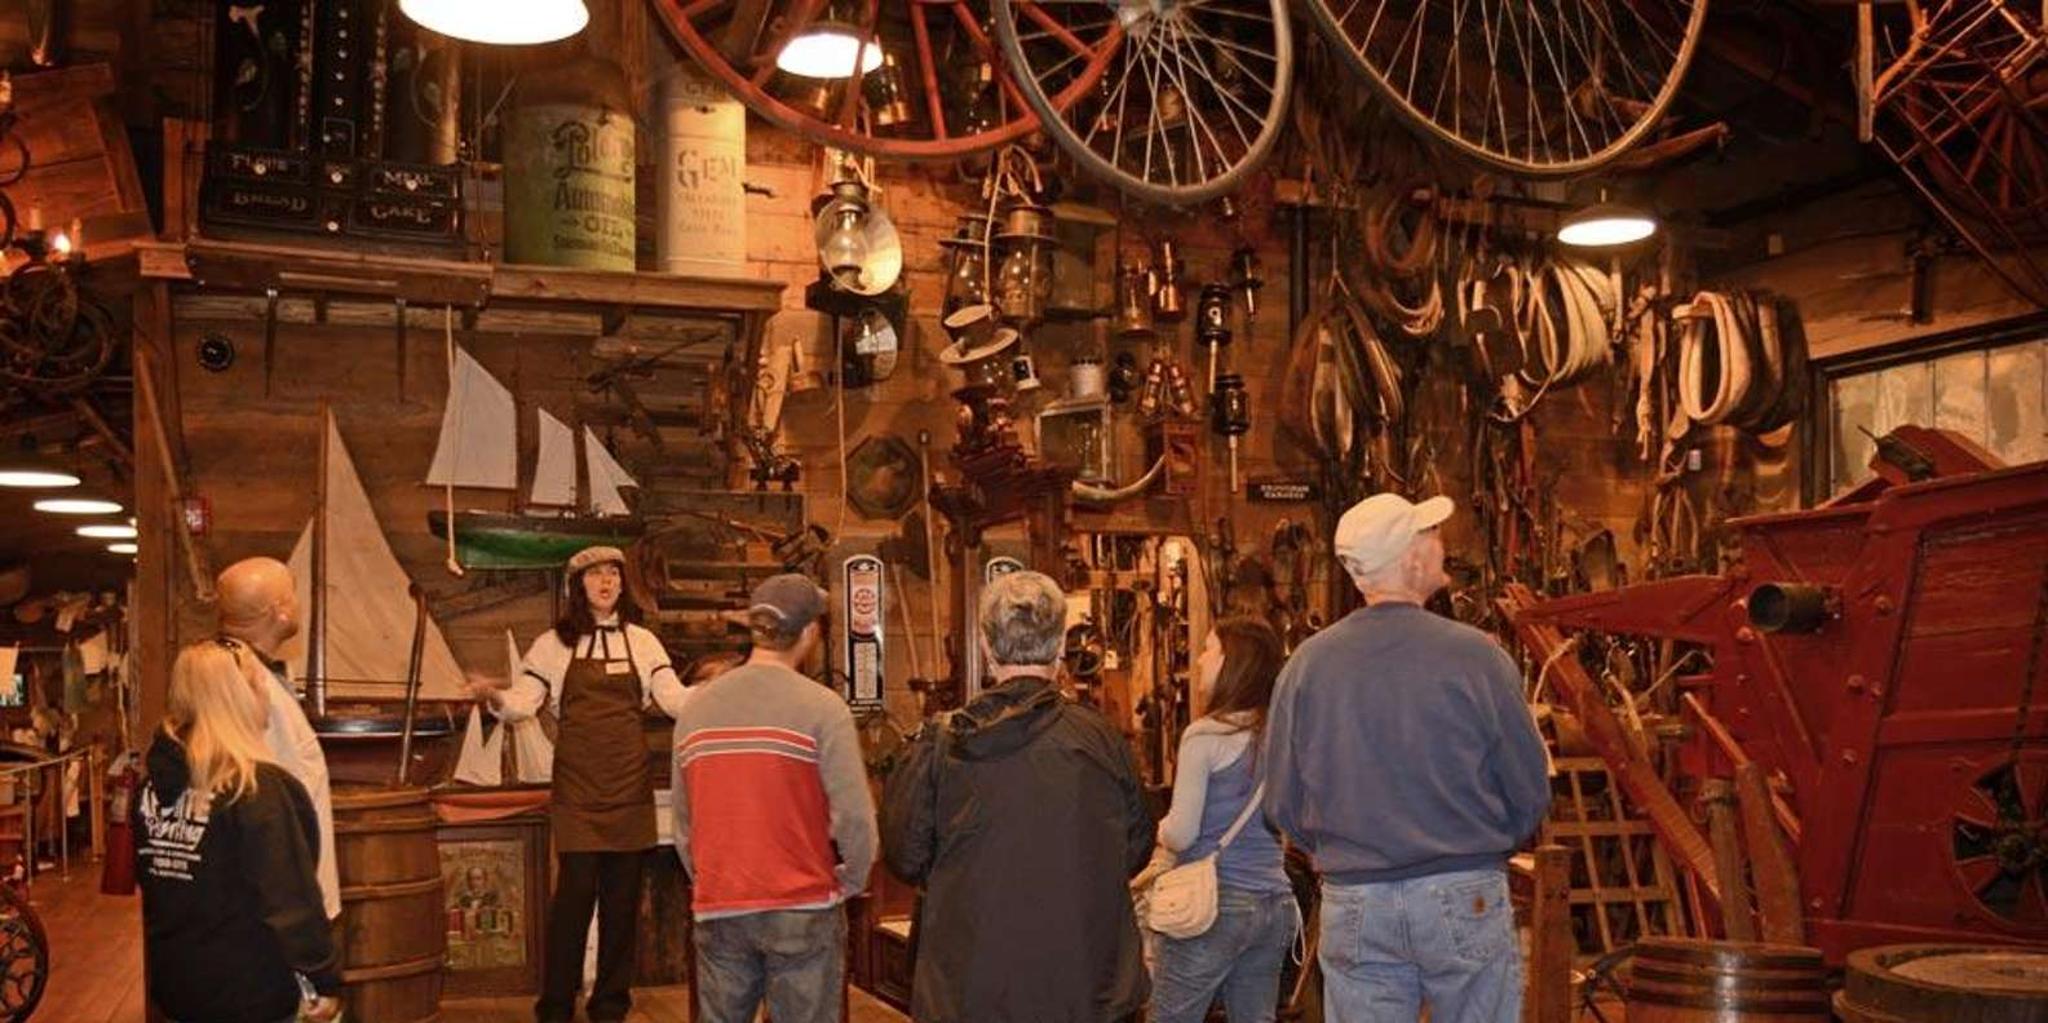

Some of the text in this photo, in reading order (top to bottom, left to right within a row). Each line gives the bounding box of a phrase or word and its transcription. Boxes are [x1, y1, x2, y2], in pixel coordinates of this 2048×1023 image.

[678, 150, 736, 188] GEM
[371, 206, 431, 223] CAKE
[585, 214, 623, 238] OIL
